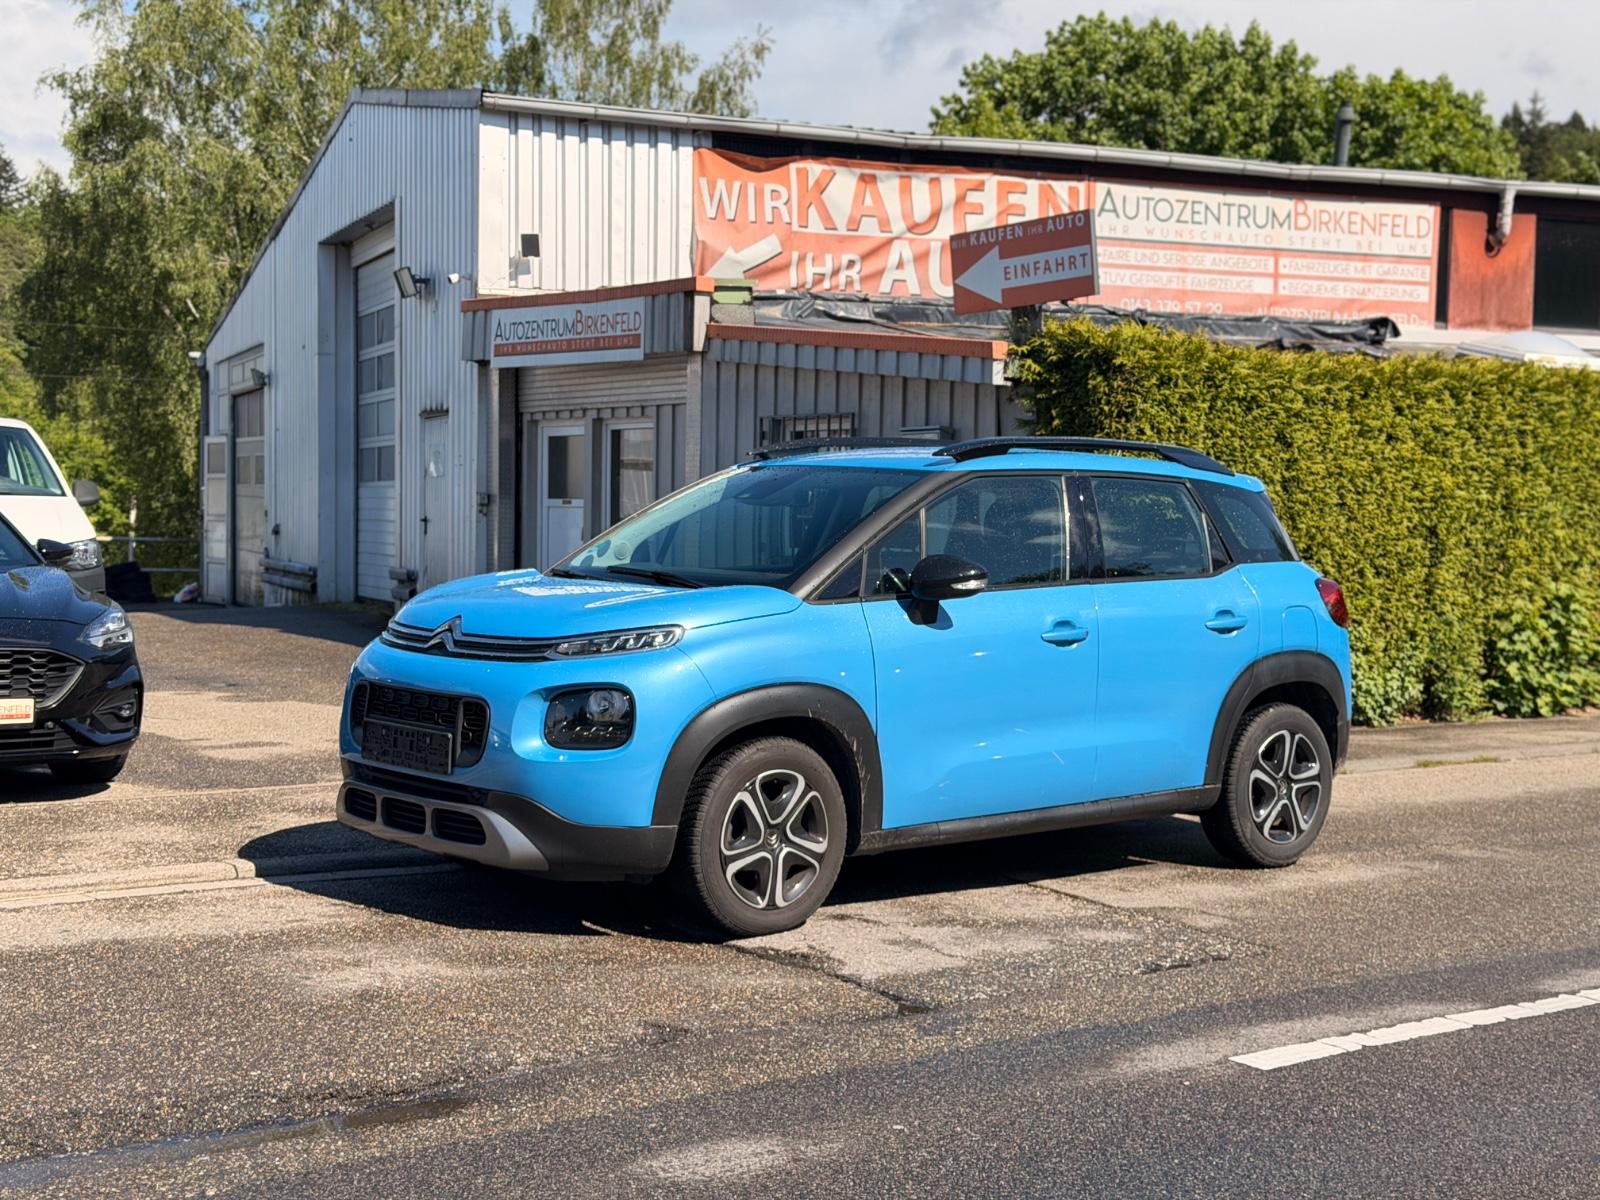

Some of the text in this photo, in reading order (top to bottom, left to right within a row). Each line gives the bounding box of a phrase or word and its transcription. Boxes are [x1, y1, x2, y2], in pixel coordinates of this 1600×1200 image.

[699, 177, 791, 224] WIR
[970, 226, 1024, 246] KAUFEN
[1047, 213, 1085, 232] AUTO
[789, 251, 862, 291] IHR
[1004, 252, 1088, 281] EINFAHRT
